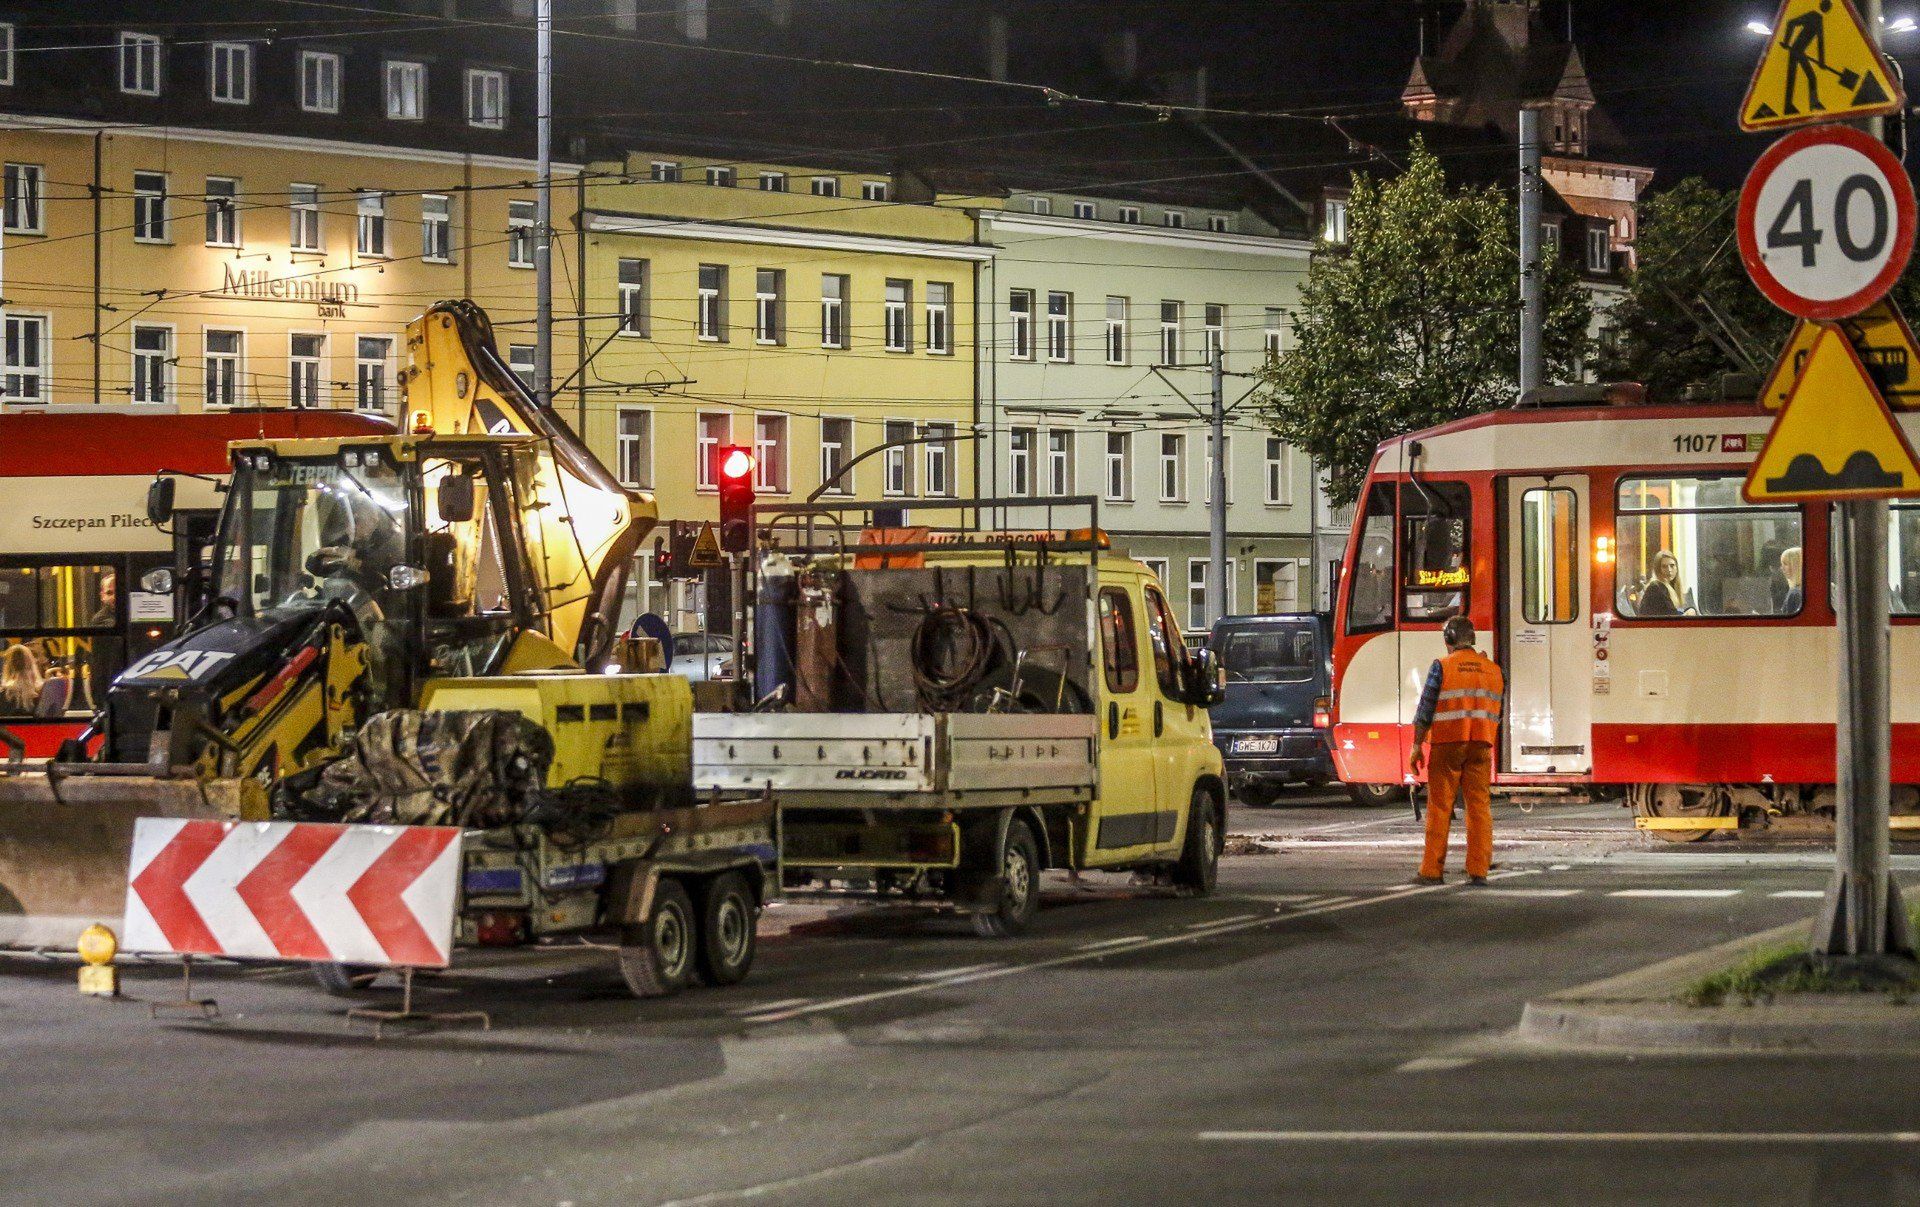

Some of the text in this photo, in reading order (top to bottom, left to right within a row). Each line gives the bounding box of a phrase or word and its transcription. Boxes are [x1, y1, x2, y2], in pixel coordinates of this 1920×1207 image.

[1766, 173, 1889, 268] 40
[222, 261, 358, 302] Millennium
[317, 304, 346, 319] bank
[1672, 434, 1717, 453] 1107
[32, 515, 106, 532] Szczepan
[120, 649, 237, 681] CAT
